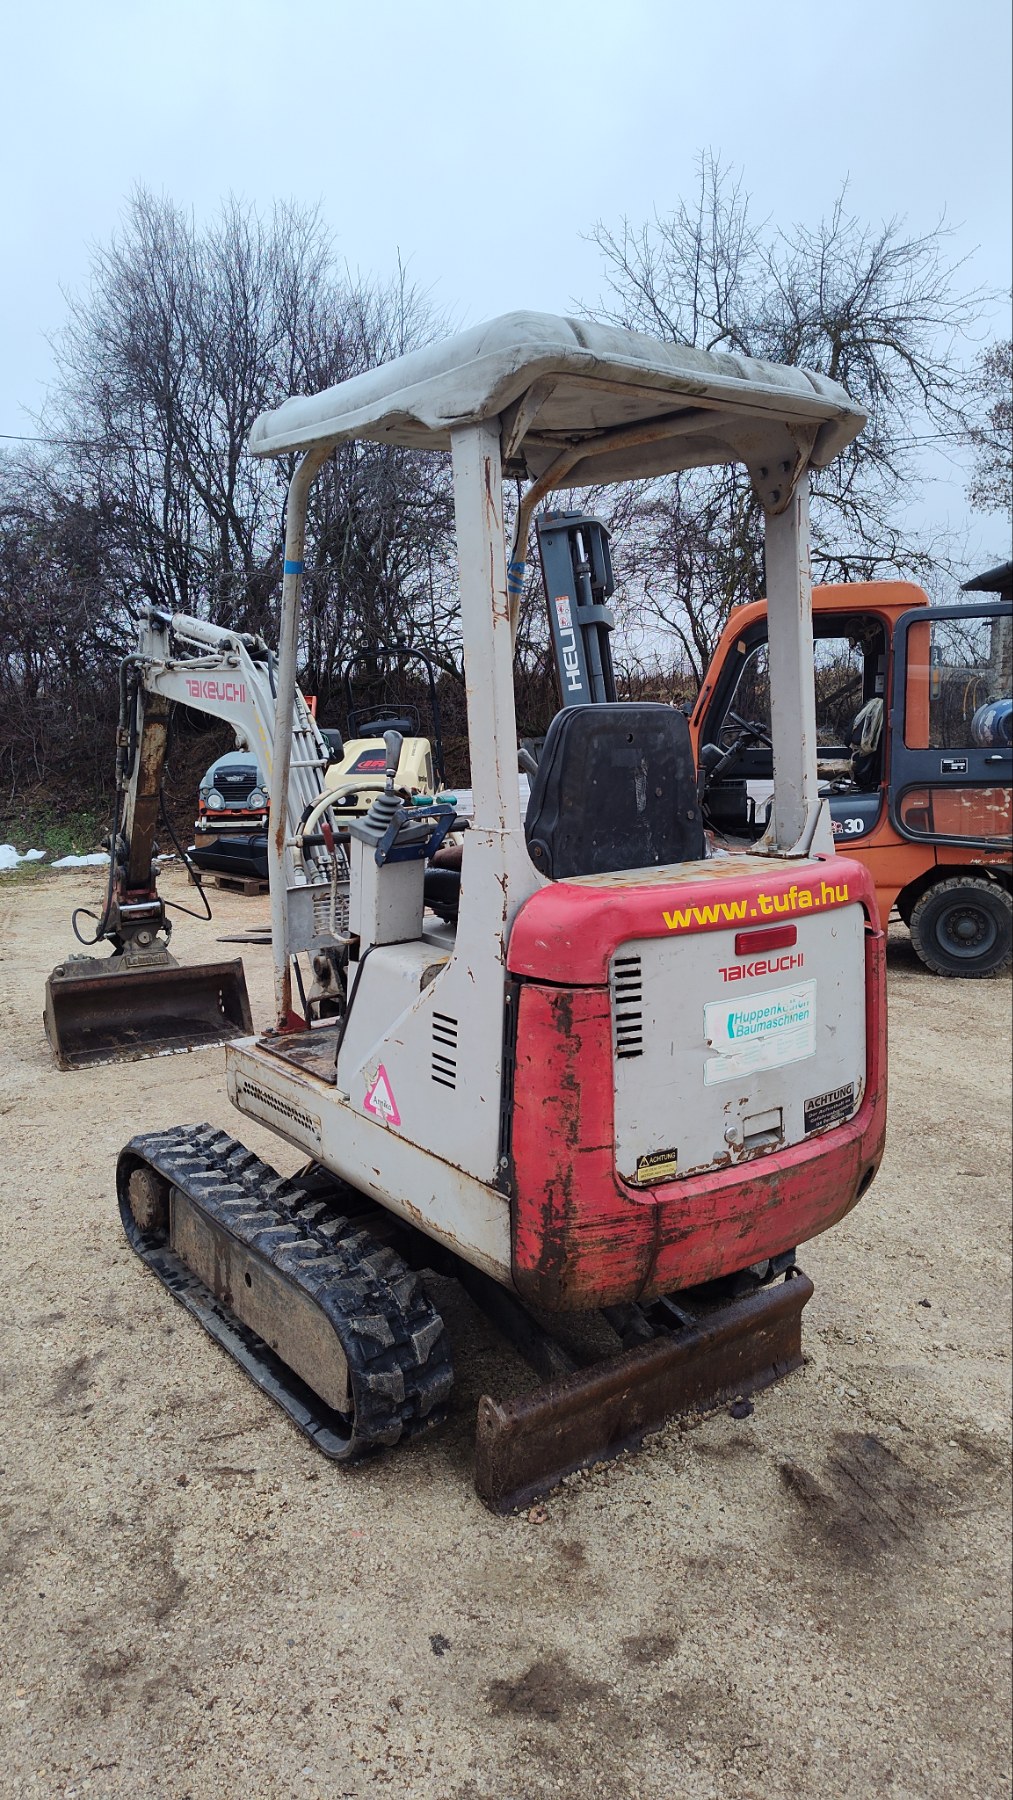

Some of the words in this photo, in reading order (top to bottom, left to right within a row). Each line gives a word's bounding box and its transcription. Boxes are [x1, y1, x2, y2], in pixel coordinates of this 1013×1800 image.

[844, 818, 864, 833] 30
[662, 881, 849, 929] www.tufa.hu
[736, 1010, 810, 1037] Baumaschinen
[807, 1085, 852, 1110] ACHTUNG
[649, 1152, 676, 1163] ACHTUNG
